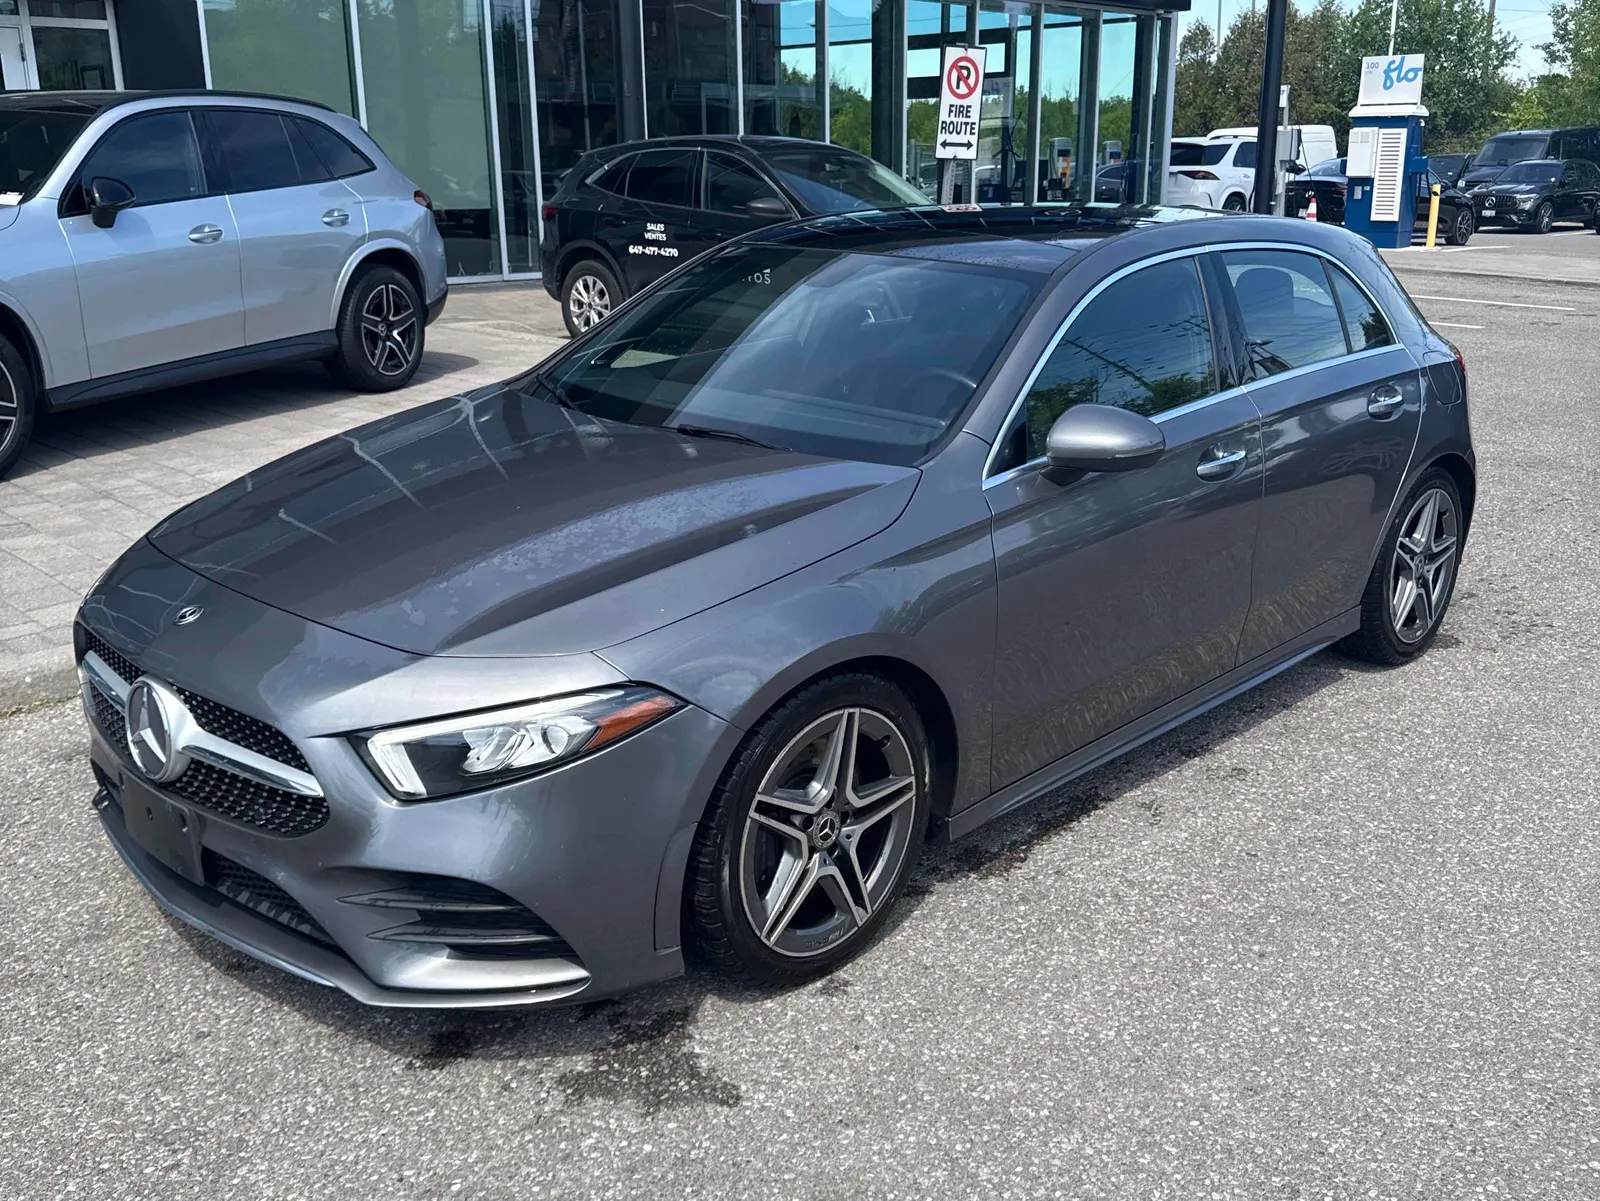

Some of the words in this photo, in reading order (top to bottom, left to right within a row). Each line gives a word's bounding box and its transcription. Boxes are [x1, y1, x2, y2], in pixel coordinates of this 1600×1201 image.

[1366, 62, 1379, 70] 100
[1382, 56, 1422, 90] flo
[948, 104, 972, 119] FIRE
[940, 120, 976, 136] ROUTE
[646, 222, 665, 231] SALES
[643, 231, 667, 241] VENTES
[628, 244, 678, 257] 647-477-4270
